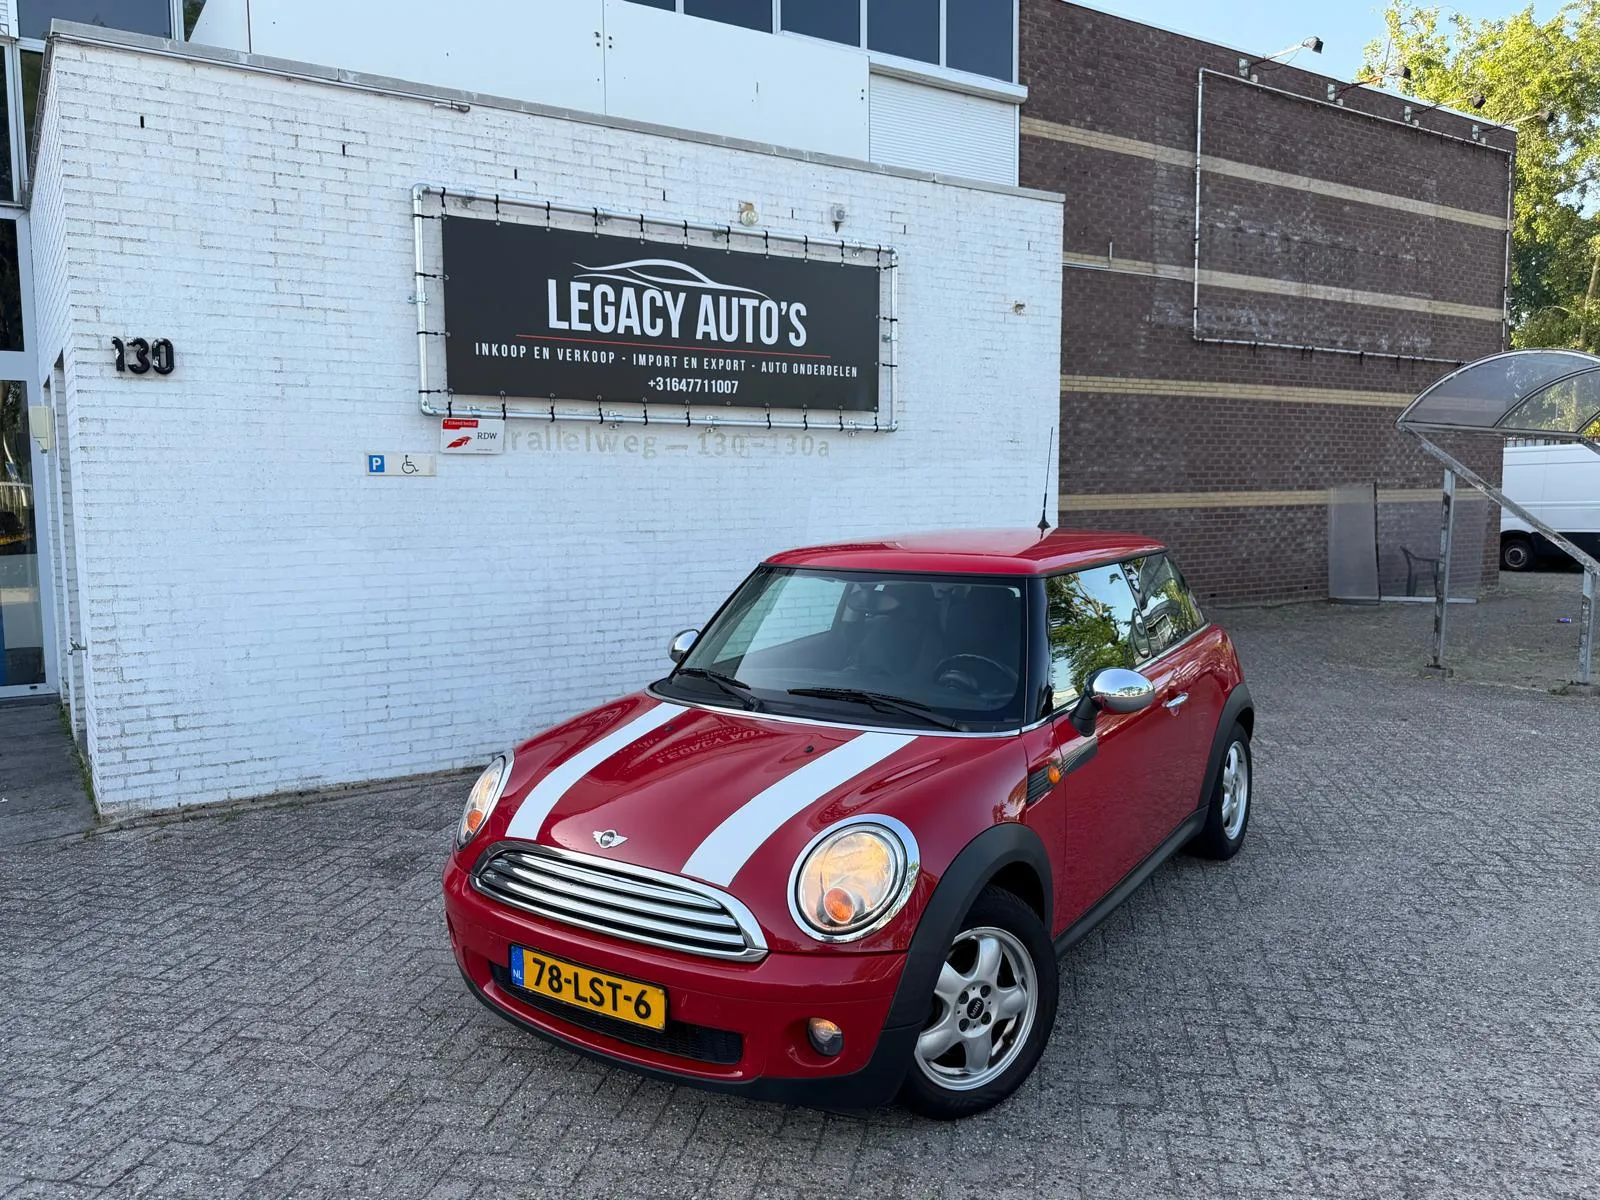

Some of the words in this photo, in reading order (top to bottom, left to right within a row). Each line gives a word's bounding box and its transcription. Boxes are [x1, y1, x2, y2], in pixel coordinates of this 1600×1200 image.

[547, 278, 687, 338] LEGACY
[695, 294, 808, 347] AUTO'S
[111, 336, 174, 375] 130
[475, 342, 527, 358] INKOOP
[534, 346, 550, 360] EN
[557, 348, 615, 364] VERKOOP
[633, 353, 677, 369] IMPORT
[684, 356, 697, 369] EN
[703, 357, 746, 371] EXPORT
[761, 361, 788, 374] AUTO
[793, 363, 858, 378] ONDERDELEN
[648, 377, 739, 394] +31647711007
[477, 432, 497, 440] RDW
[511, 425, 658, 459] rallelweg
[372, 457, 382, 471] P
[512, 969, 523, 980] NL
[532, 957, 652, 1020] 78-LST-6
